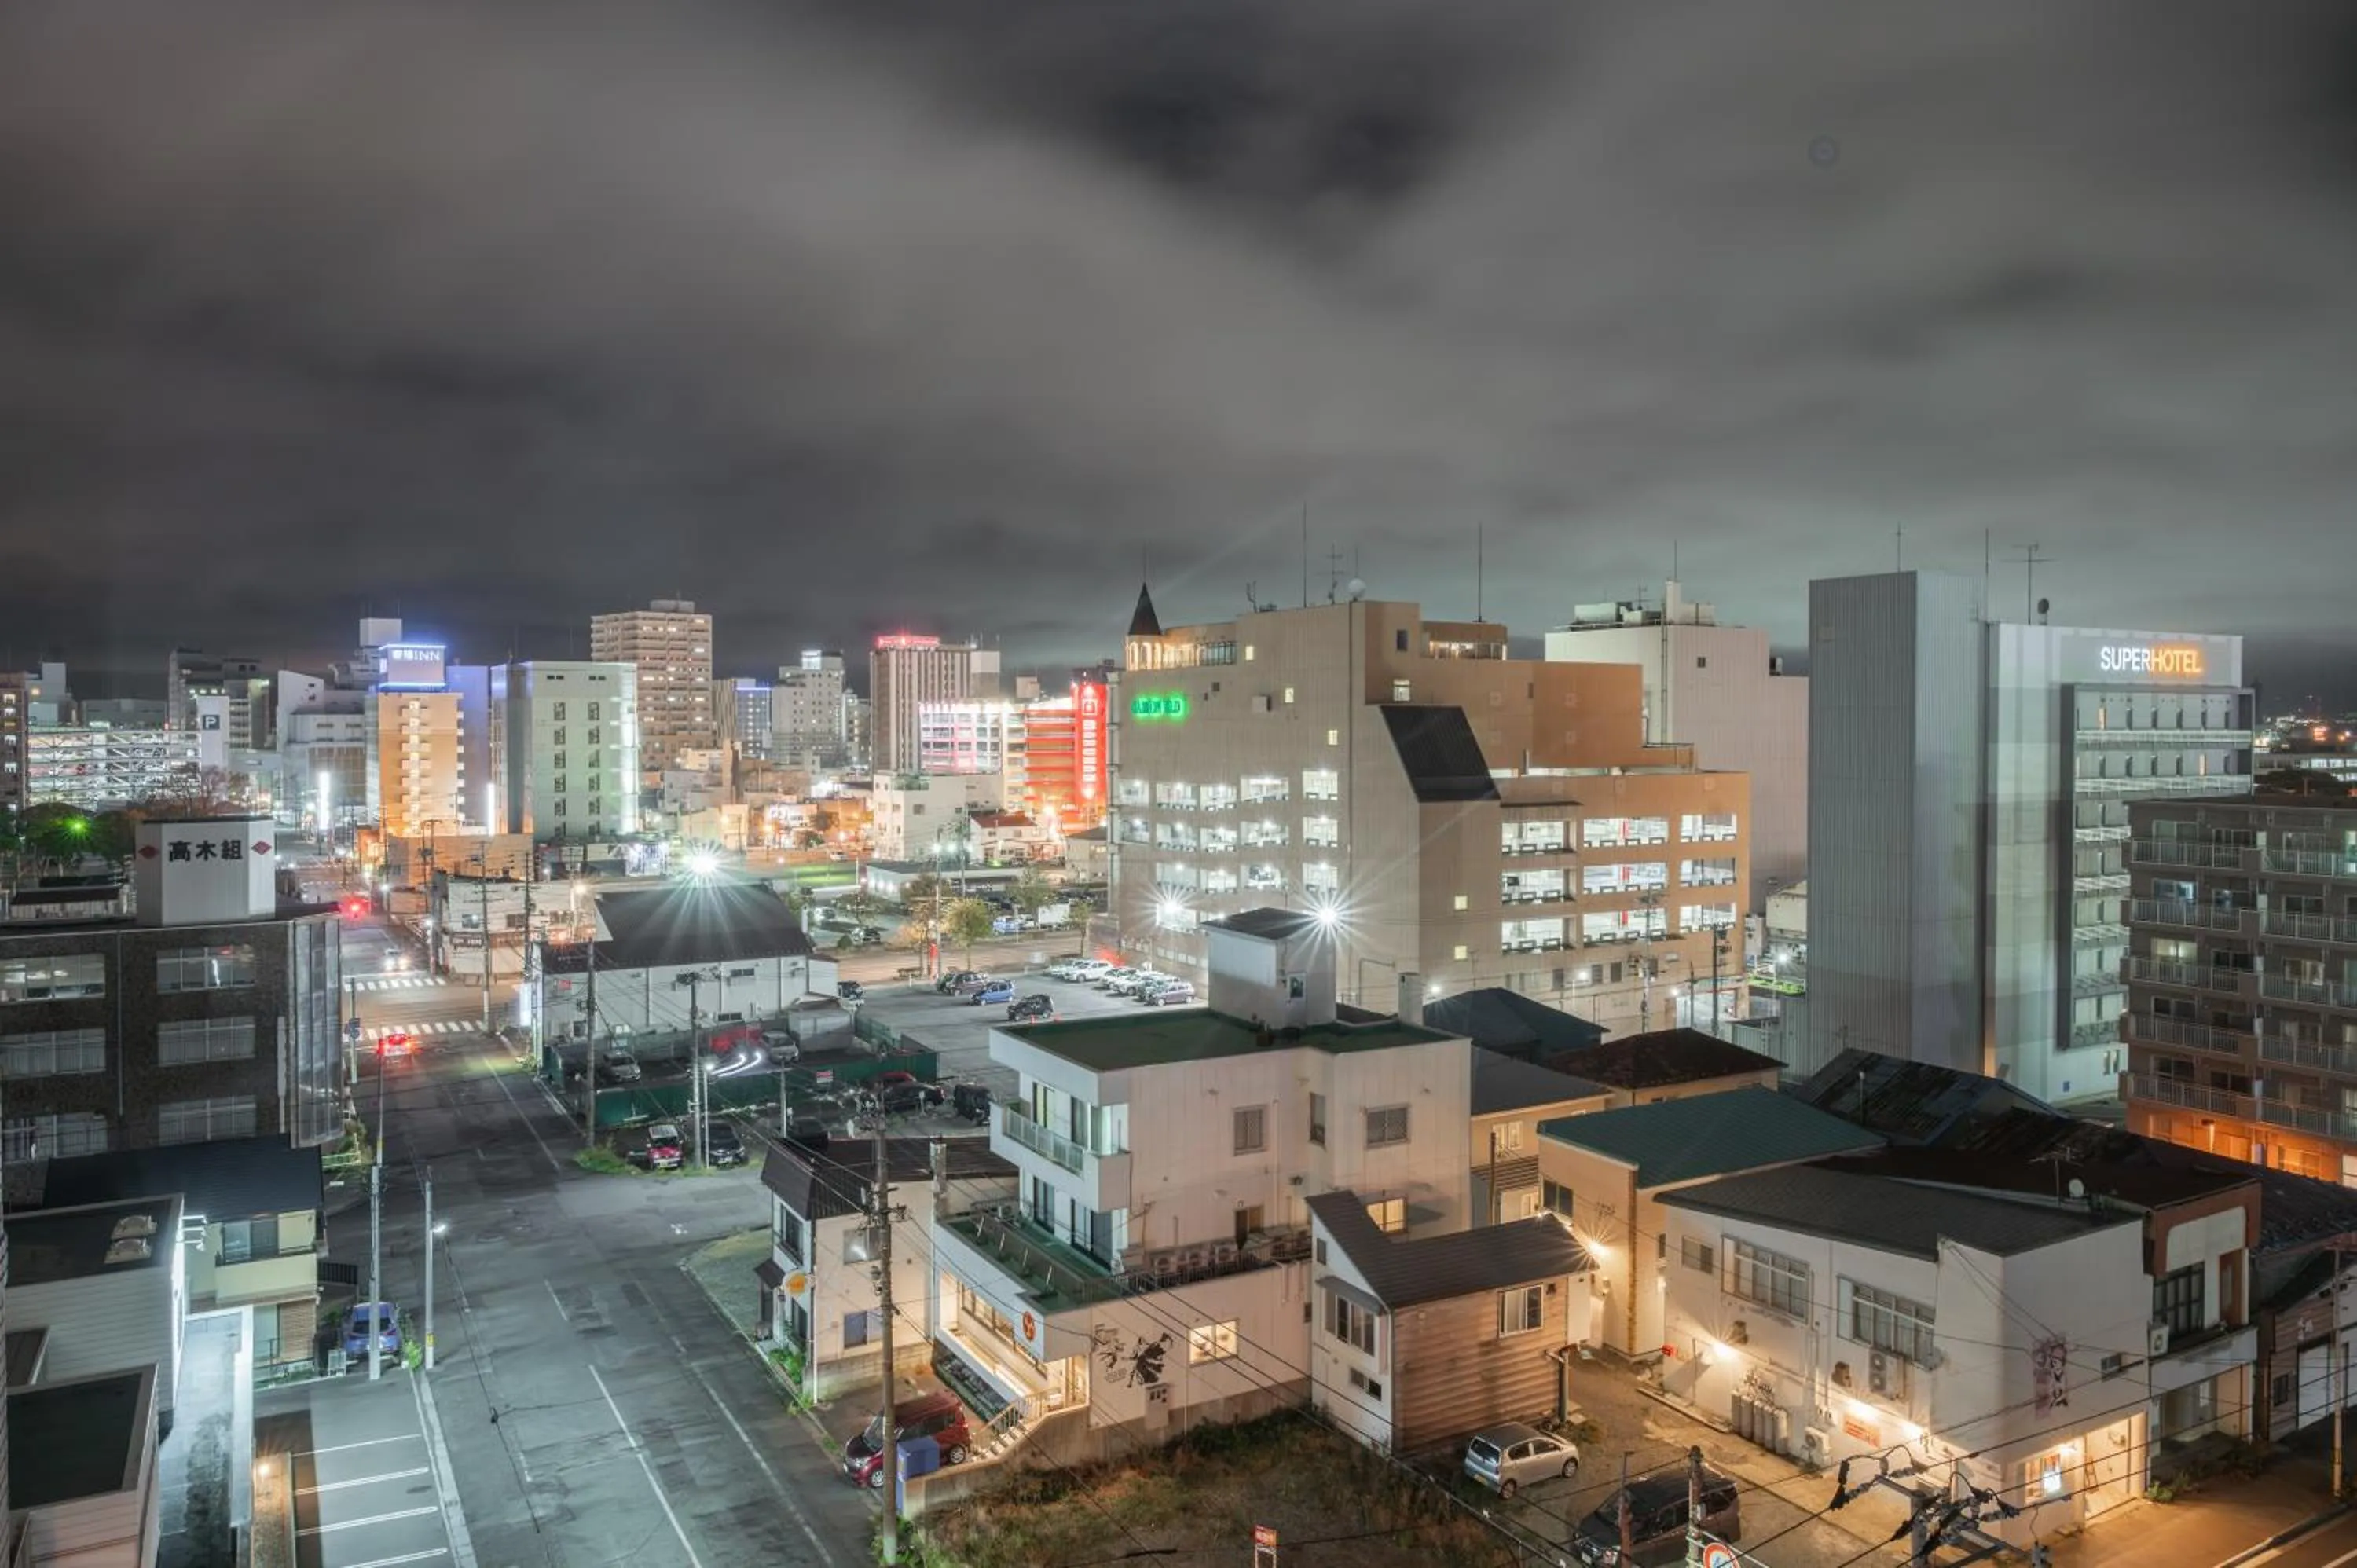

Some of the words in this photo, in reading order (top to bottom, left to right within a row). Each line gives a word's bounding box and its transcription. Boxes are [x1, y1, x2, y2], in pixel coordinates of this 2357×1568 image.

[205, 716, 217, 729] P
[168, 840, 243, 862] 高木組
